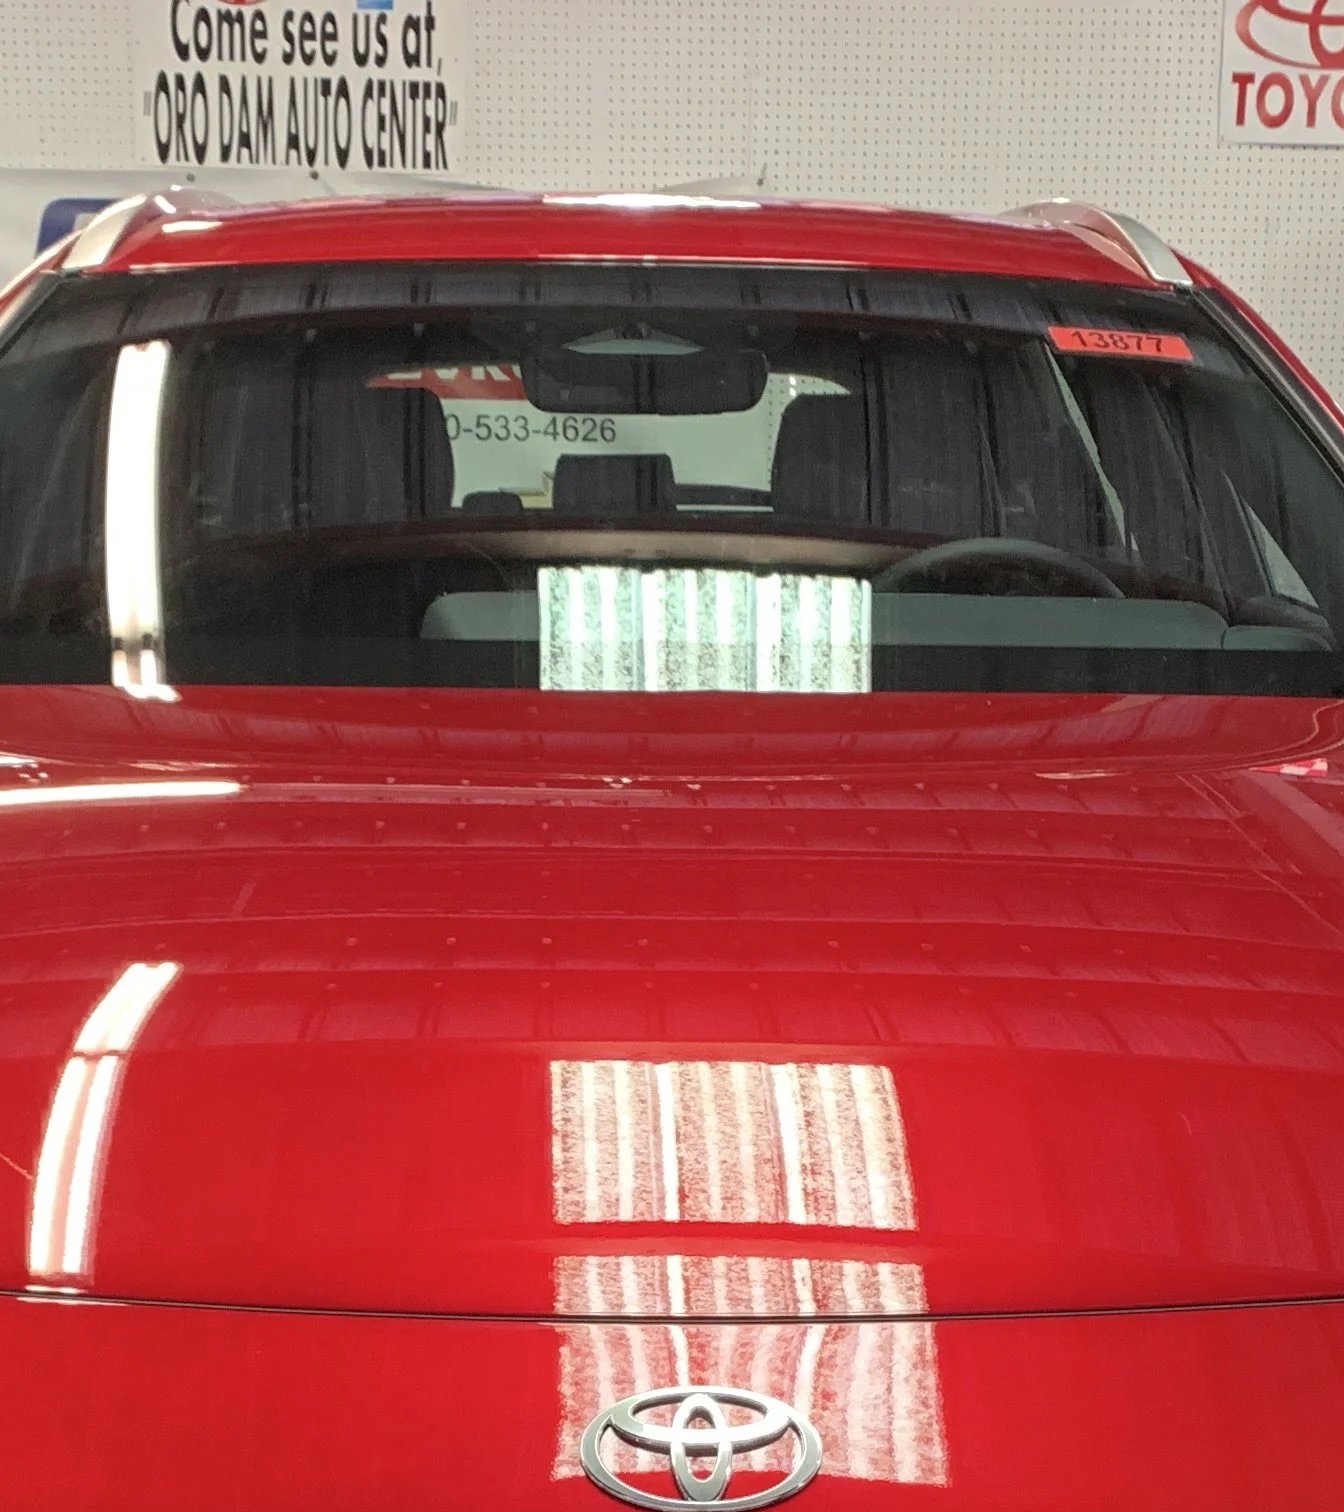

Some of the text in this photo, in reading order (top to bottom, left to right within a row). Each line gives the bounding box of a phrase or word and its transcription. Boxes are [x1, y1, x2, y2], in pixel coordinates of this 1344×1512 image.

[170, 0, 268, 65] Come
[281, 9, 339, 66] see
[352, 11, 388, 68] us
[154, 70, 449, 170] ORO DAM AUTO CENTER
[1071, 331, 1162, 353] 13877
